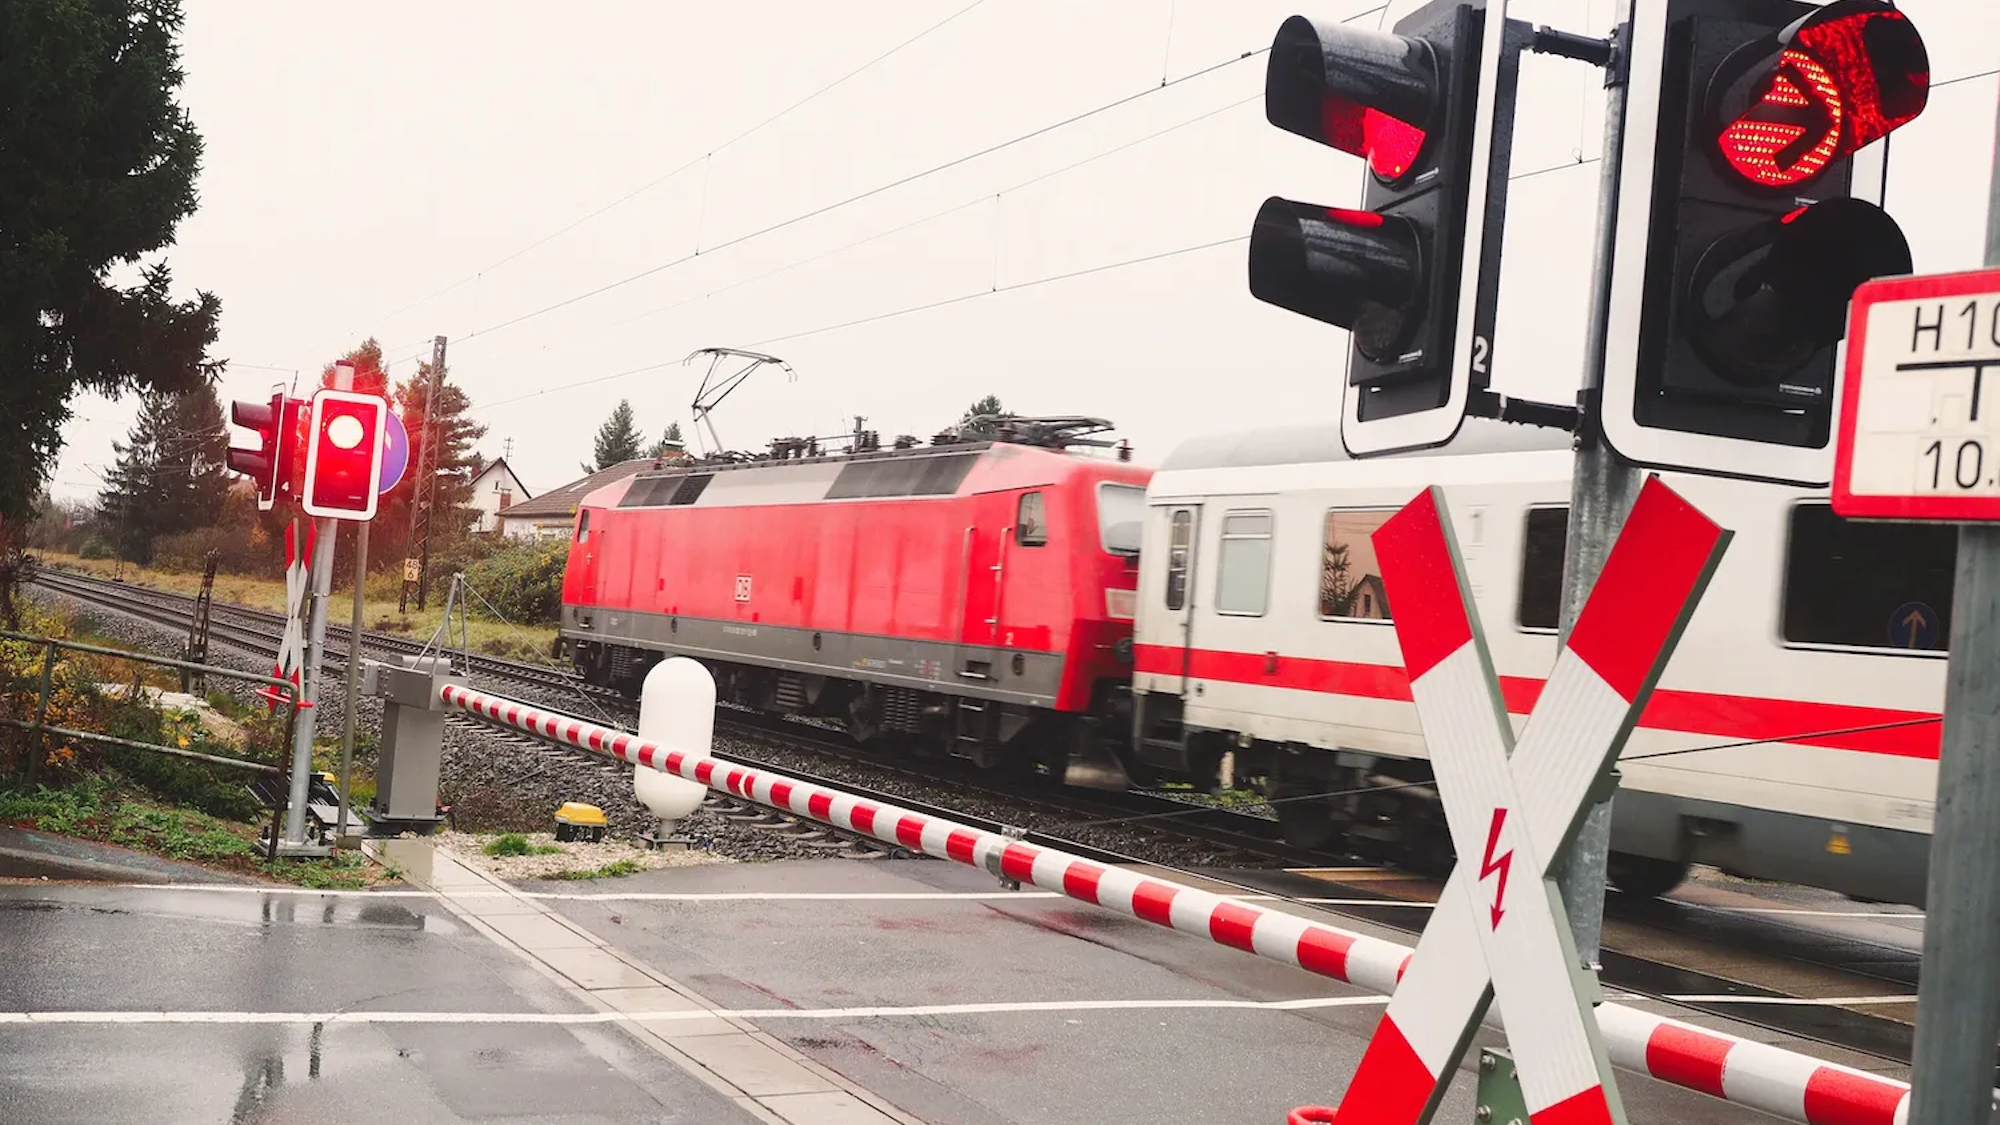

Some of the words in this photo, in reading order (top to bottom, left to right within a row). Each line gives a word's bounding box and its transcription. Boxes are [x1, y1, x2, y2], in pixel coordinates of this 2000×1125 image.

[1472, 335, 1489, 373] 2
[281, 481, 290, 492] 4
[406, 560, 418, 570] 48
[407, 570, 414, 579] 6
[736, 577, 751, 600] DB
[1005, 632, 1014, 645] 2
